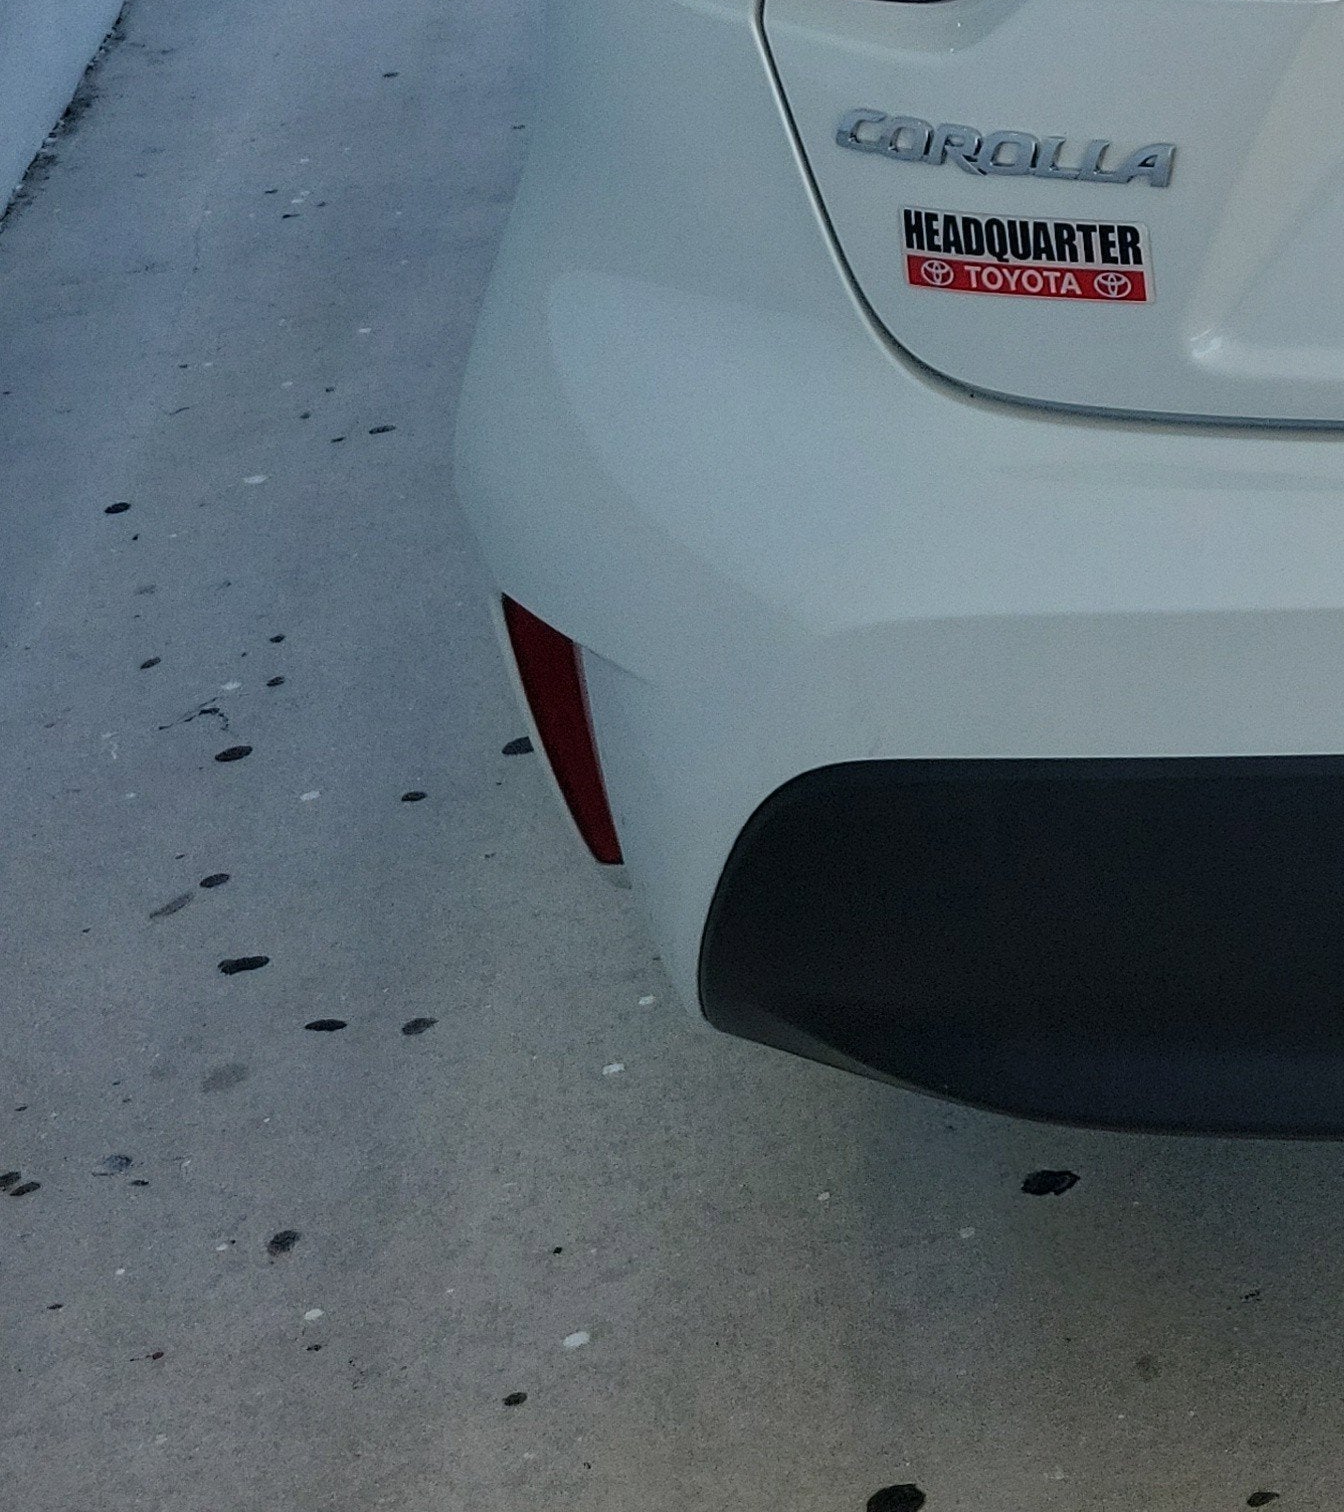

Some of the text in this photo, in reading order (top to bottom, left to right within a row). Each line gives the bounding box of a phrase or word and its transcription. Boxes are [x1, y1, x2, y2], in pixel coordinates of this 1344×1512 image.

[835, 107, 1178, 188] COROLLA
[903, 207, 1143, 266] HEADQUARTER
[963, 264, 1083, 296] TOYOTA
